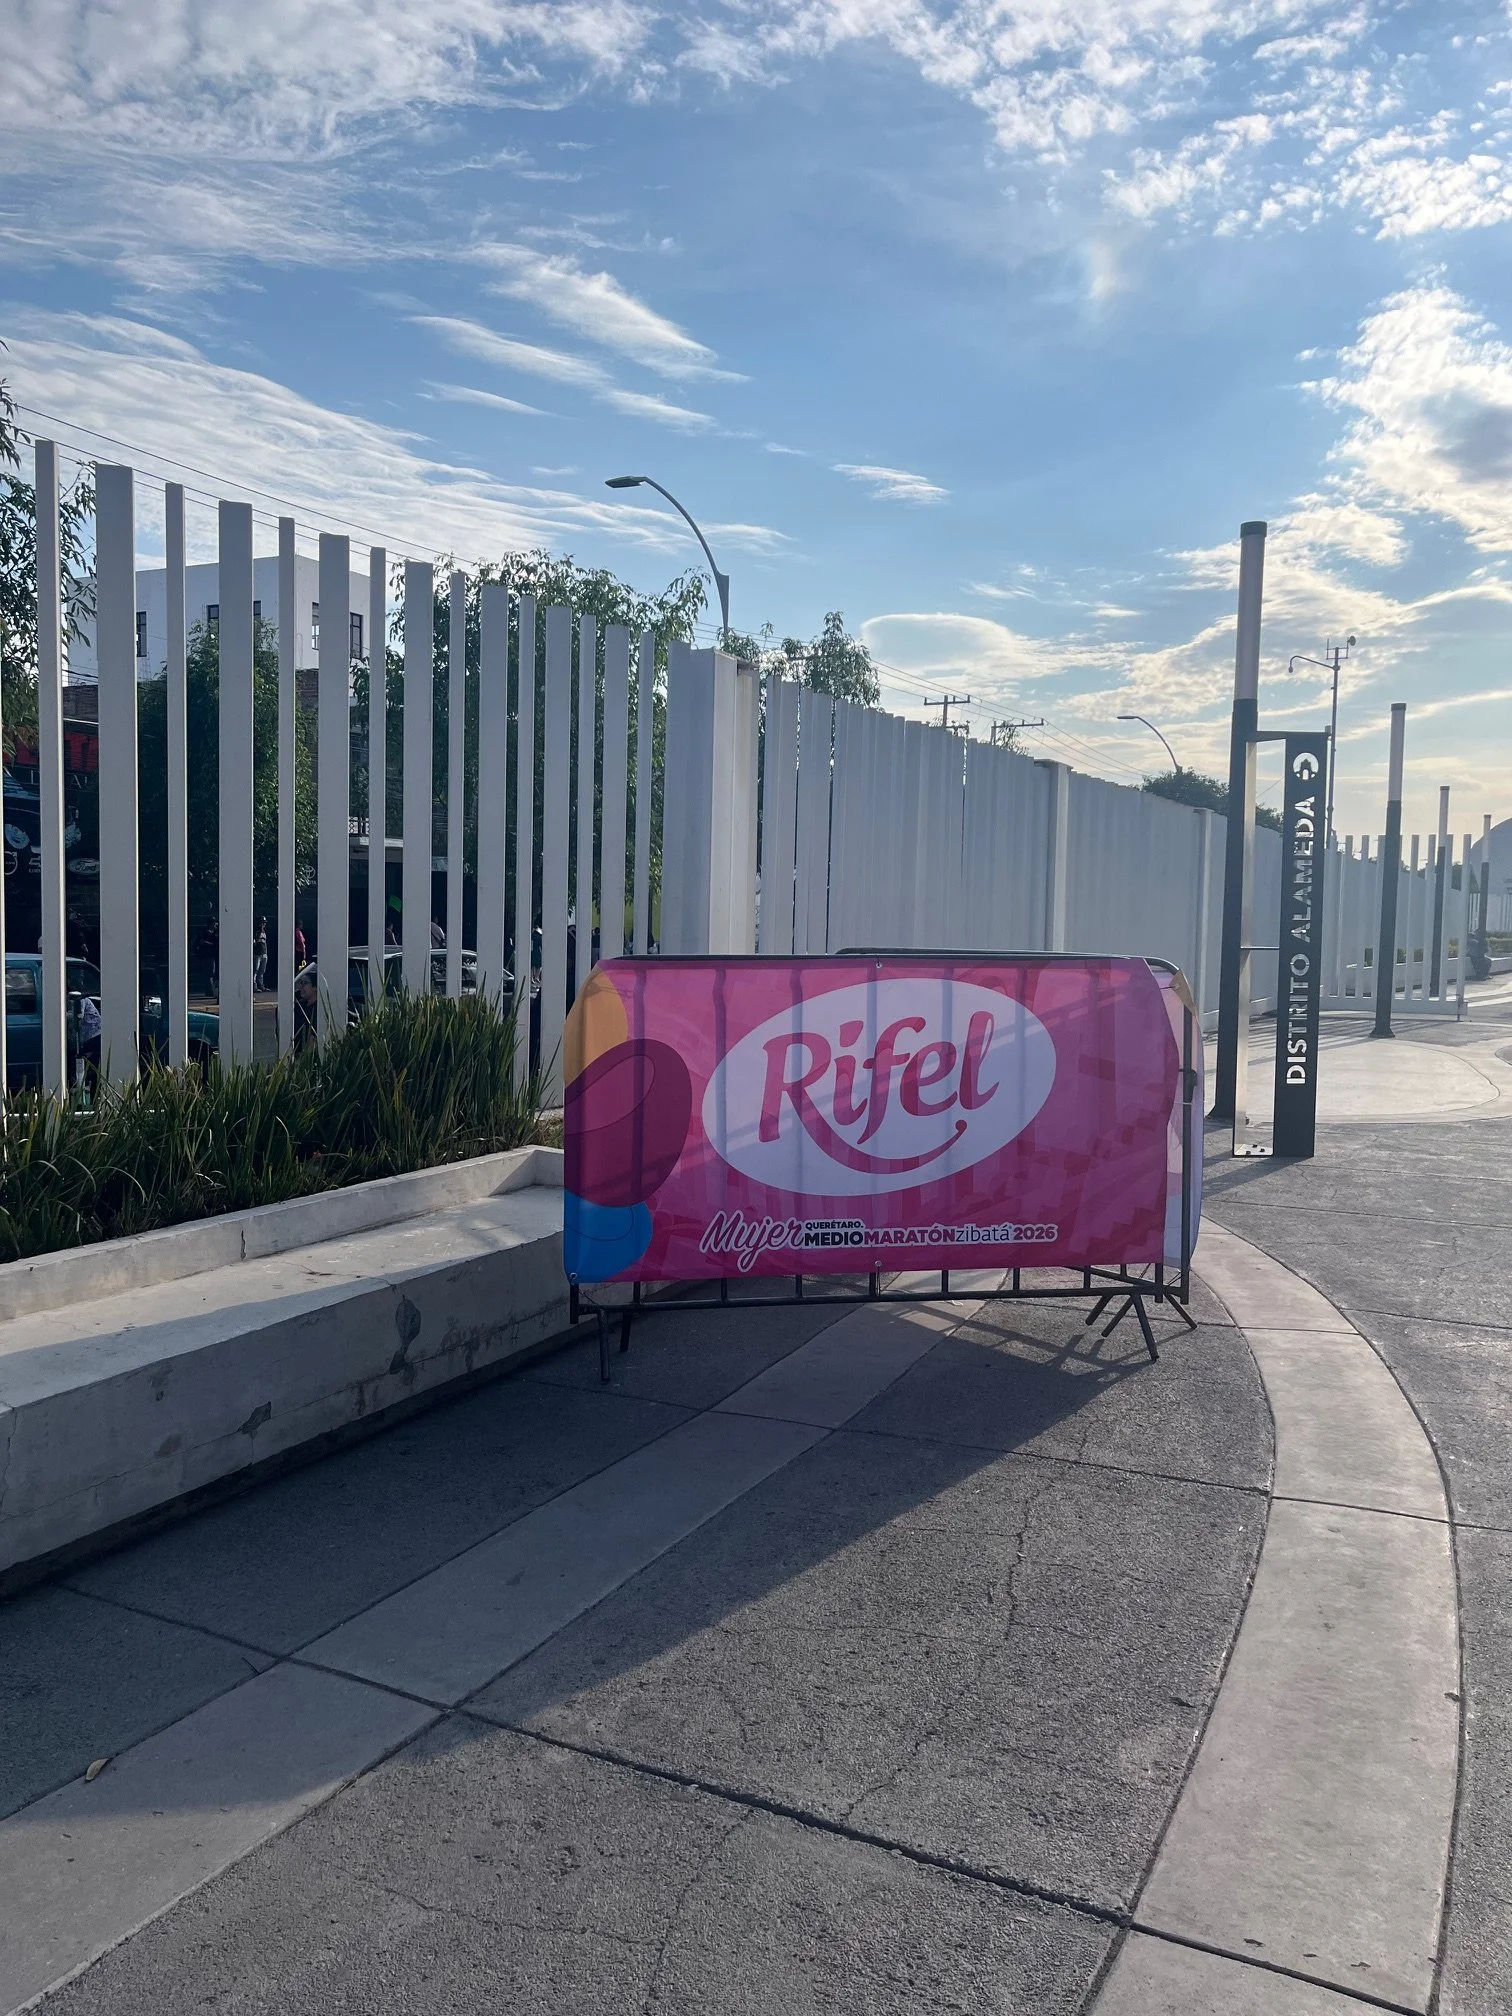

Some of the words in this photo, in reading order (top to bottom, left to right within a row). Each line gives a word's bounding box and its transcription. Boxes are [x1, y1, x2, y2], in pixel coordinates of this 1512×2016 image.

[1290, 796, 1316, 943] ALAMEDA
[1286, 953, 1310, 1085] DISTRITO
[758, 1010, 1000, 1175] Rifel
[701, 1211, 805, 1271] Mujer
[1013, 1226, 1057, 1241] 2026
